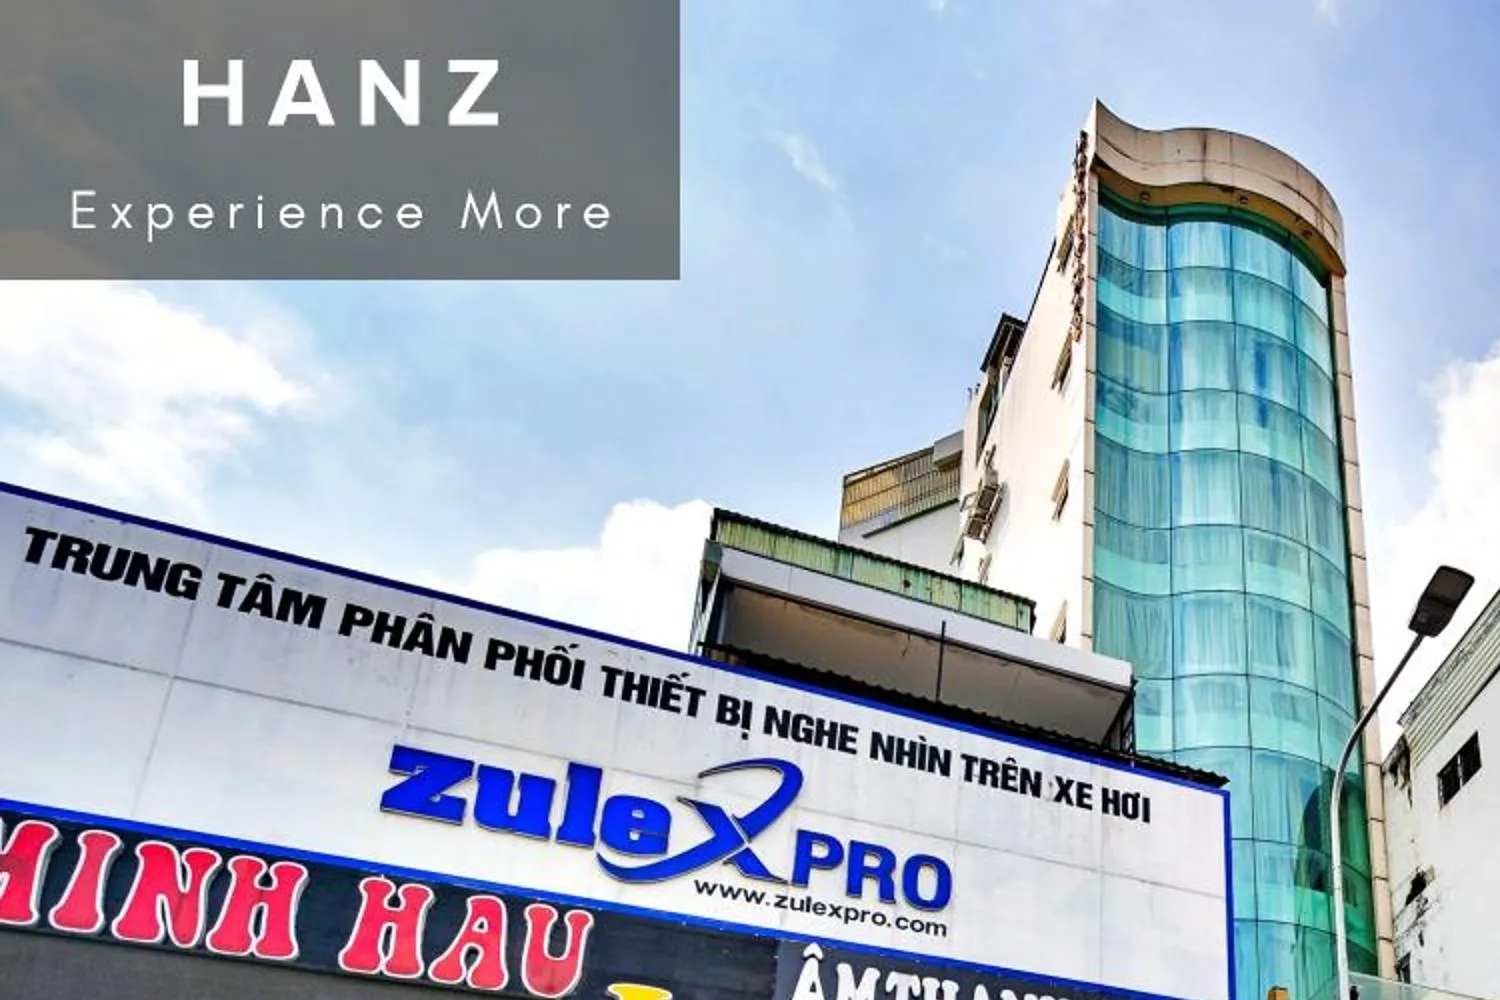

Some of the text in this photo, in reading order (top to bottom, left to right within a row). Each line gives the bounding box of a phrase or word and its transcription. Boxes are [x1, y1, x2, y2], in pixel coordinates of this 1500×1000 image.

[24, 526, 1152, 823] TRUNG TÂM PHÂN PHỐI THIẾT BỊ NGHE NHÌN TRÊN XE HƠI
[338, 875, 594, 999] HAU
[693, 877, 948, 938] www.zulexpro.com
